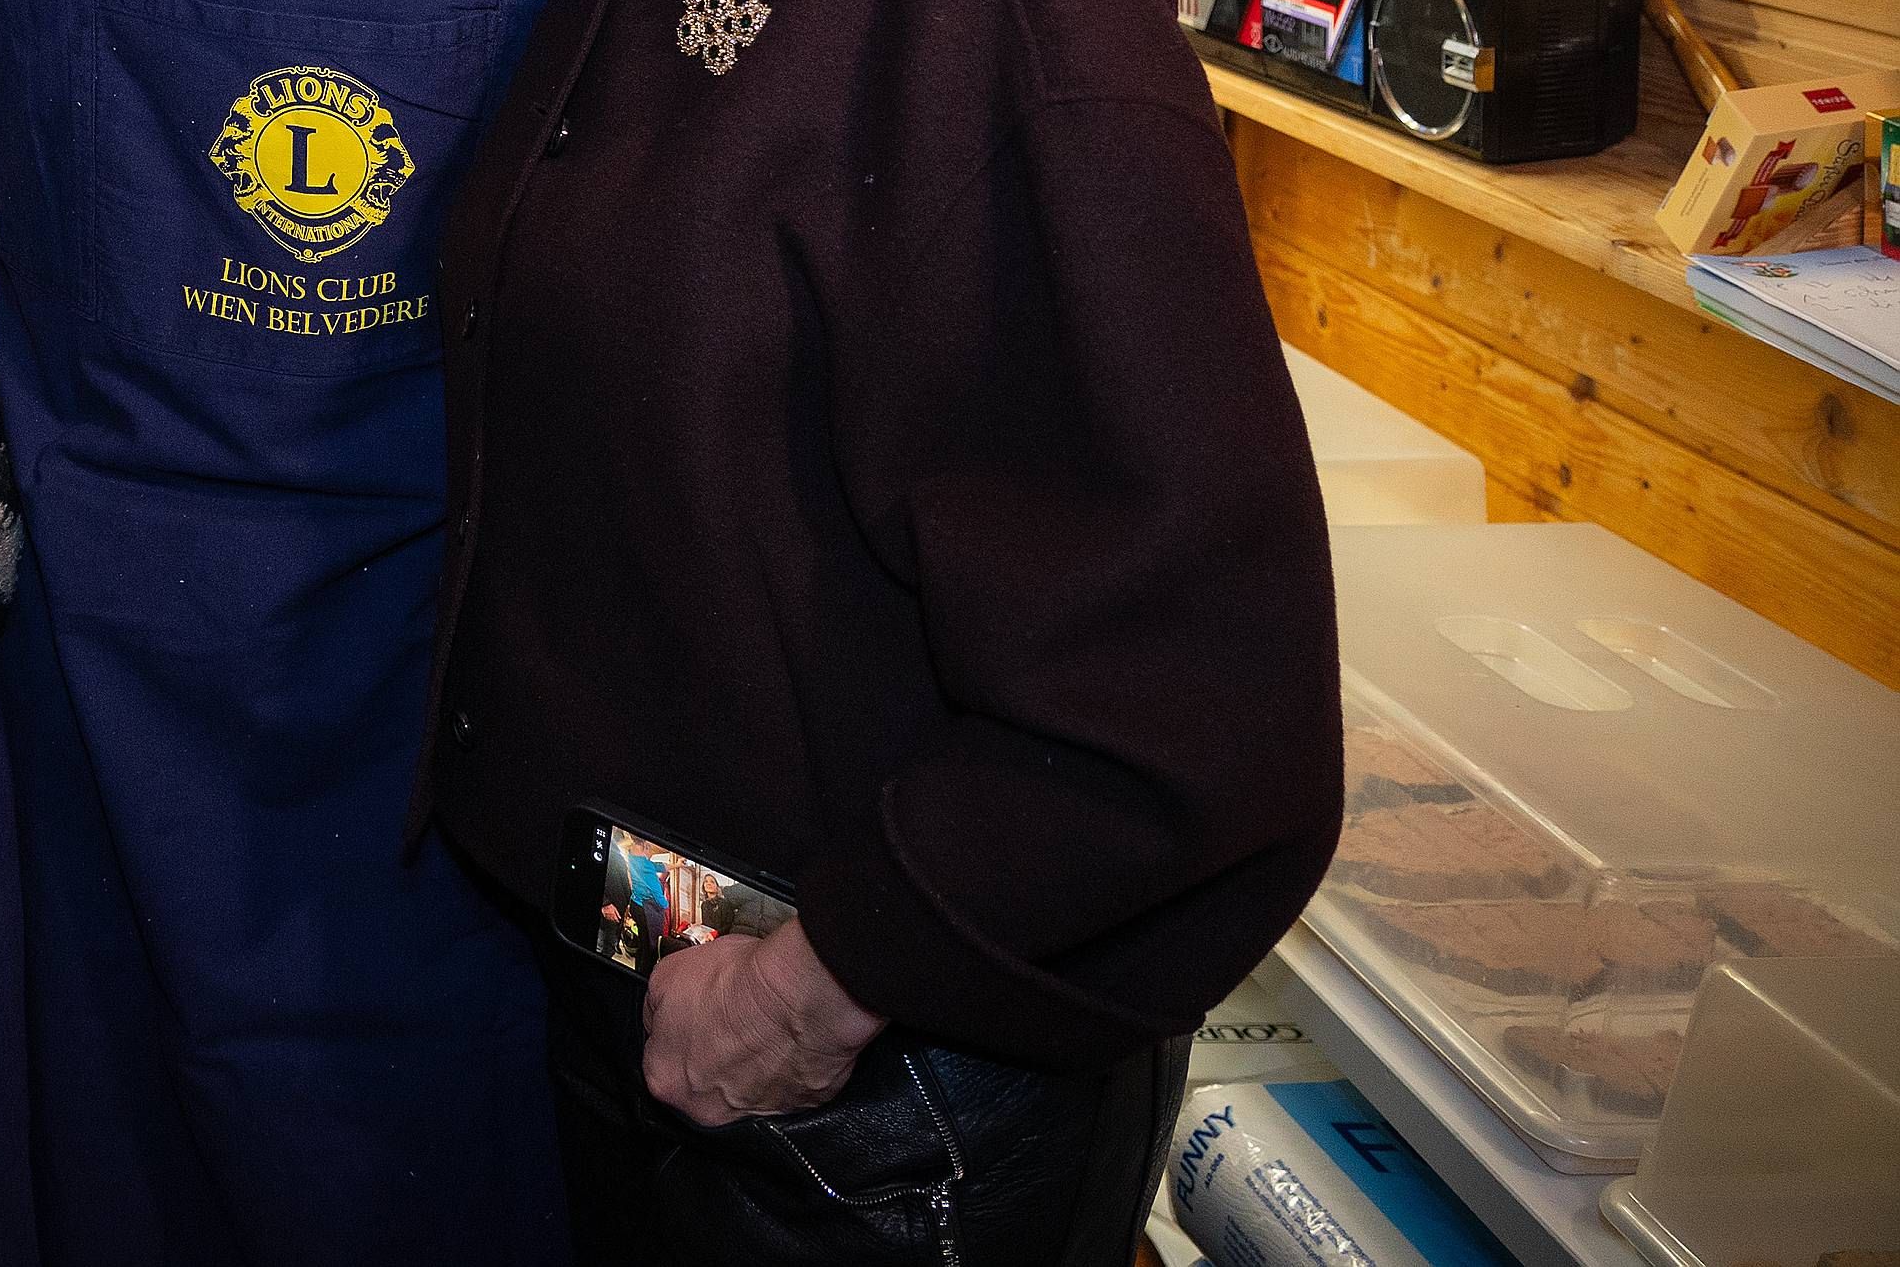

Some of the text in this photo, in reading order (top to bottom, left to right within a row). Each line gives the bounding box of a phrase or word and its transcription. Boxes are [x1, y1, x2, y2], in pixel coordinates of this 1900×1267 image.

[260, 76, 371, 120] LIONS
[284, 124, 339, 195] L
[220, 257, 397, 302] LIONS CLUB
[182, 284, 430, 335] WIEN BELVEDERE
[1177, 1104, 1235, 1213] FUNNY
